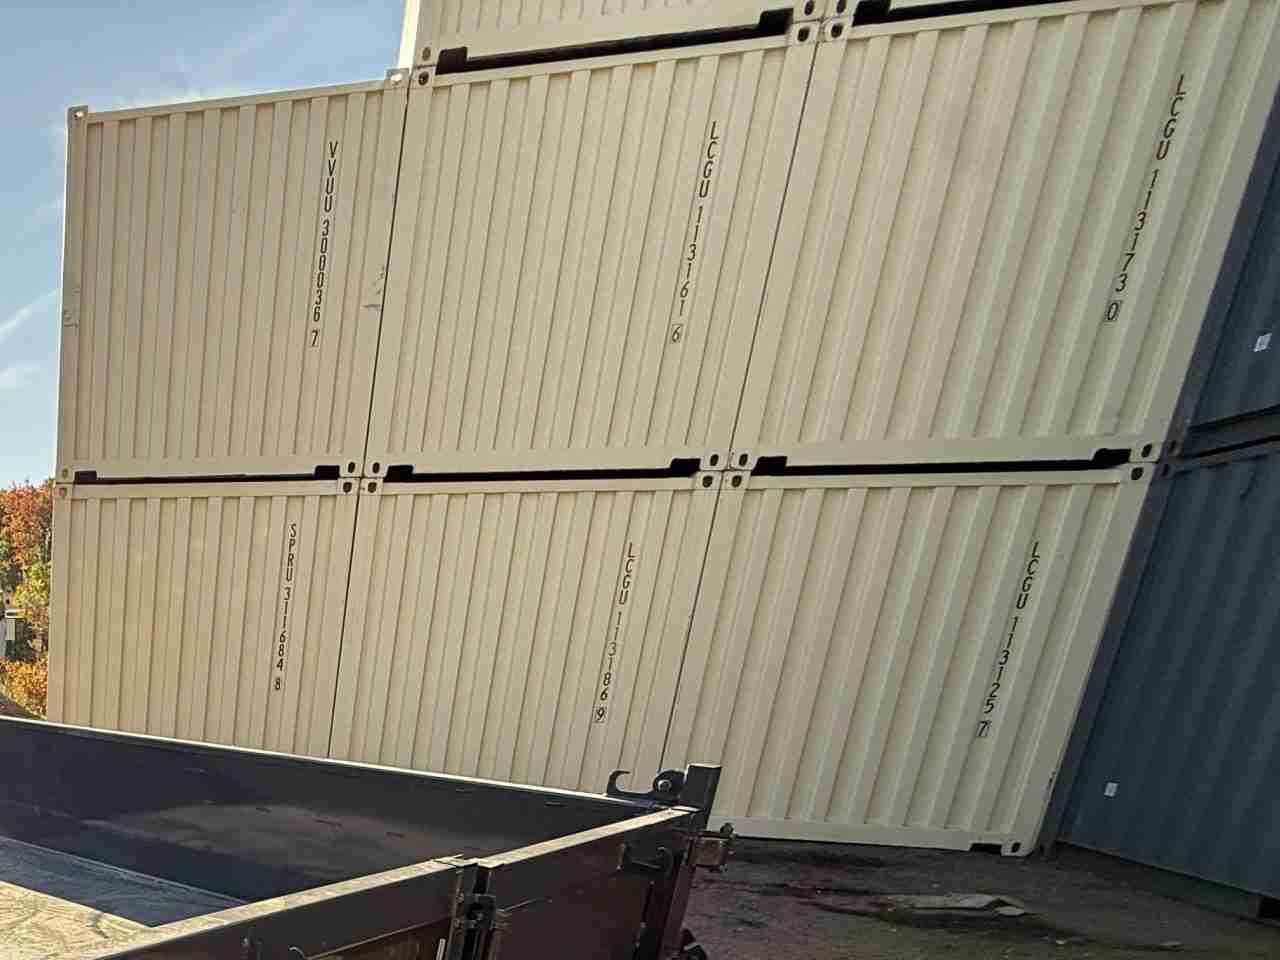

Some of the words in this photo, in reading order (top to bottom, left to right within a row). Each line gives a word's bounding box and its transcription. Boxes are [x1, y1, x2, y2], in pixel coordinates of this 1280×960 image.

[1156, 74, 1186, 160] LCGU
[323, 140, 339, 213] VVUU
[699, 120, 719, 198] LCGU
[679, 205, 703, 316] 113161
[1115, 168, 1159, 292] 113173
[313, 219, 330, 322] 300036
[311, 329, 319, 347] 7
[671, 325, 682, 343] 6
[285, 523, 297, 582] SPRU
[618, 541, 636, 606] LCGU
[1016, 541, 1040, 610] LCGU
[276, 586, 291, 672] 311684
[600, 611, 623, 701] 113186
[983, 615, 1019, 714] 113125
[596, 706, 606, 722] 9
